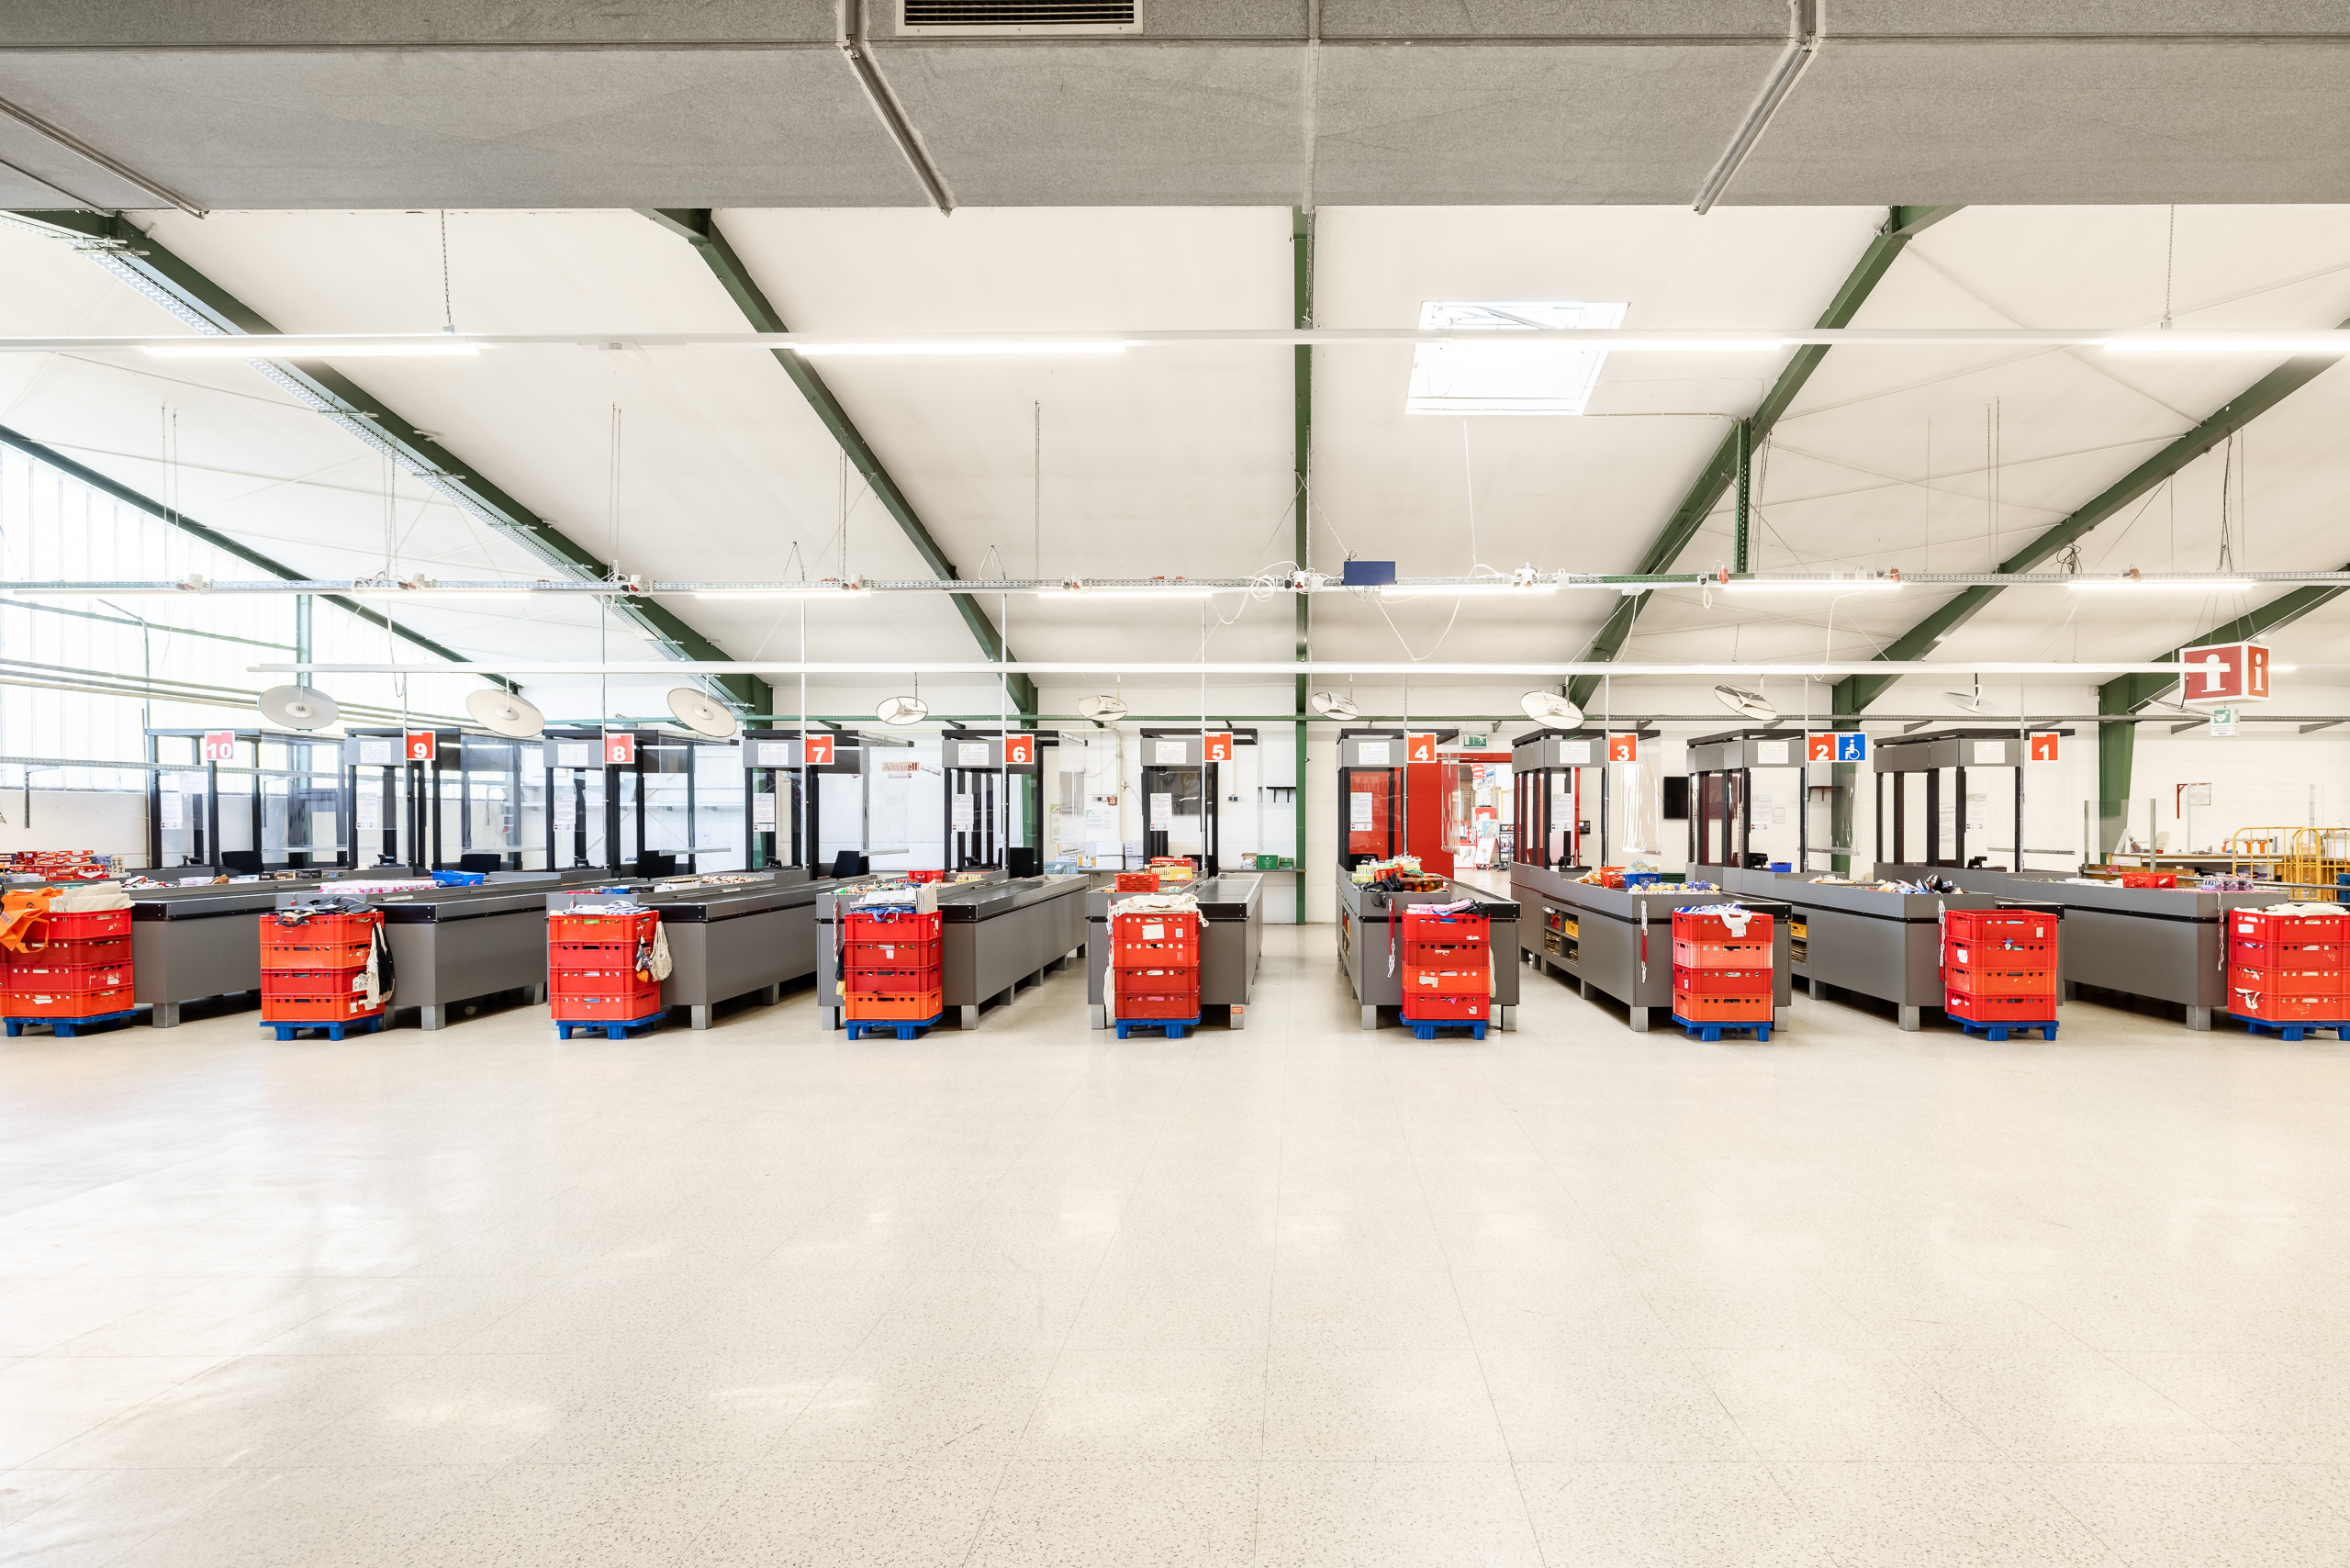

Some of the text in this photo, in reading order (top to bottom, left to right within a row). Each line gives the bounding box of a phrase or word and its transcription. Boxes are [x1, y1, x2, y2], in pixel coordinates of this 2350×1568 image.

[2254, 653, 2264, 690] i
[207, 743, 232, 758] 10
[414, 743, 427, 758] 9
[613, 745, 626, 762] 8
[812, 747, 826, 762] 7
[1013, 746, 1025, 762] 6
[1212, 745, 1225, 760] 5
[1415, 745, 1428, 760] 4
[1617, 745, 1629, 761] 3
[1816, 745, 1829, 760] 2
[2039, 745, 2049, 760] 1
[883, 762, 918, 771] Aktuell
